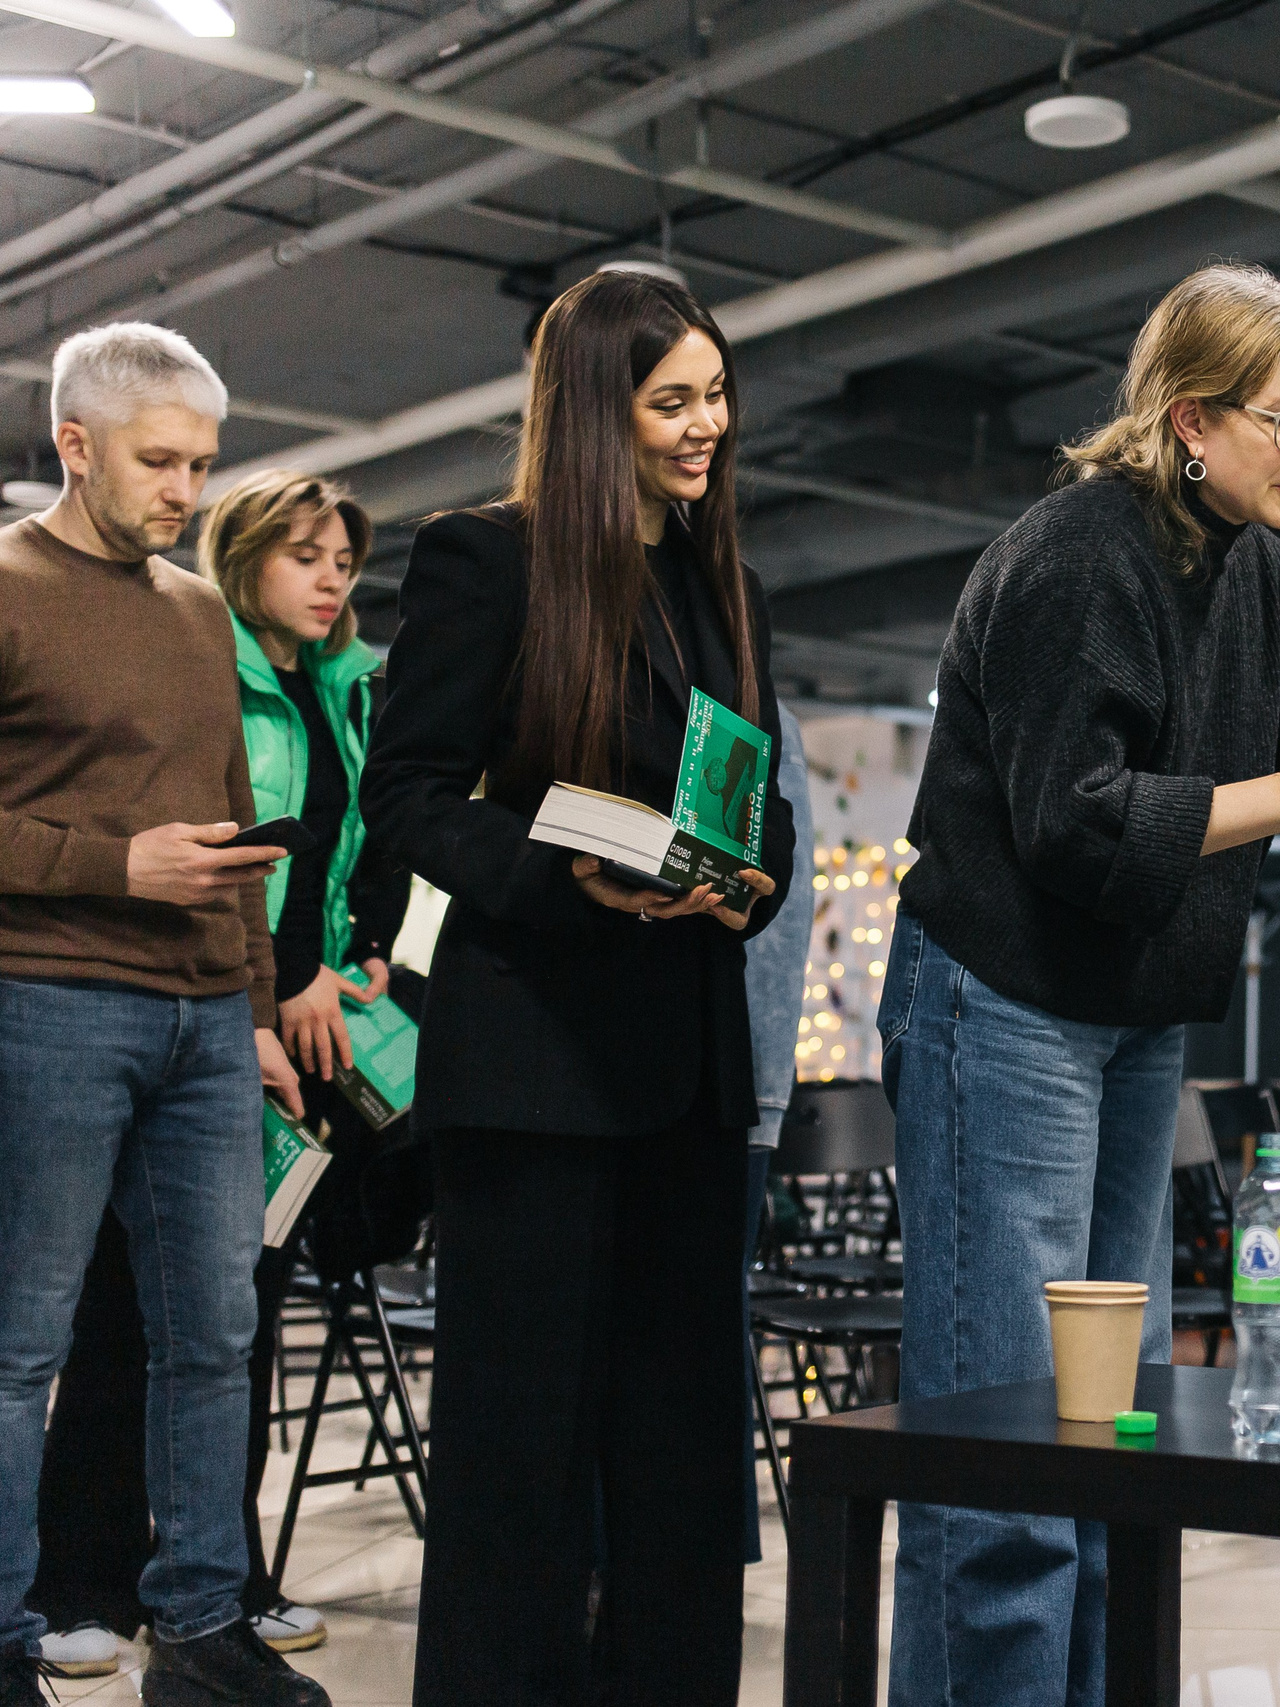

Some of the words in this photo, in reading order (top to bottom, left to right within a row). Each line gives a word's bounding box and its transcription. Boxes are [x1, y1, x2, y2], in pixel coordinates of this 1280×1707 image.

[750, 781, 765, 866] пацана
[669, 843, 692, 860] слово
[664, 854, 691, 873] пацана
